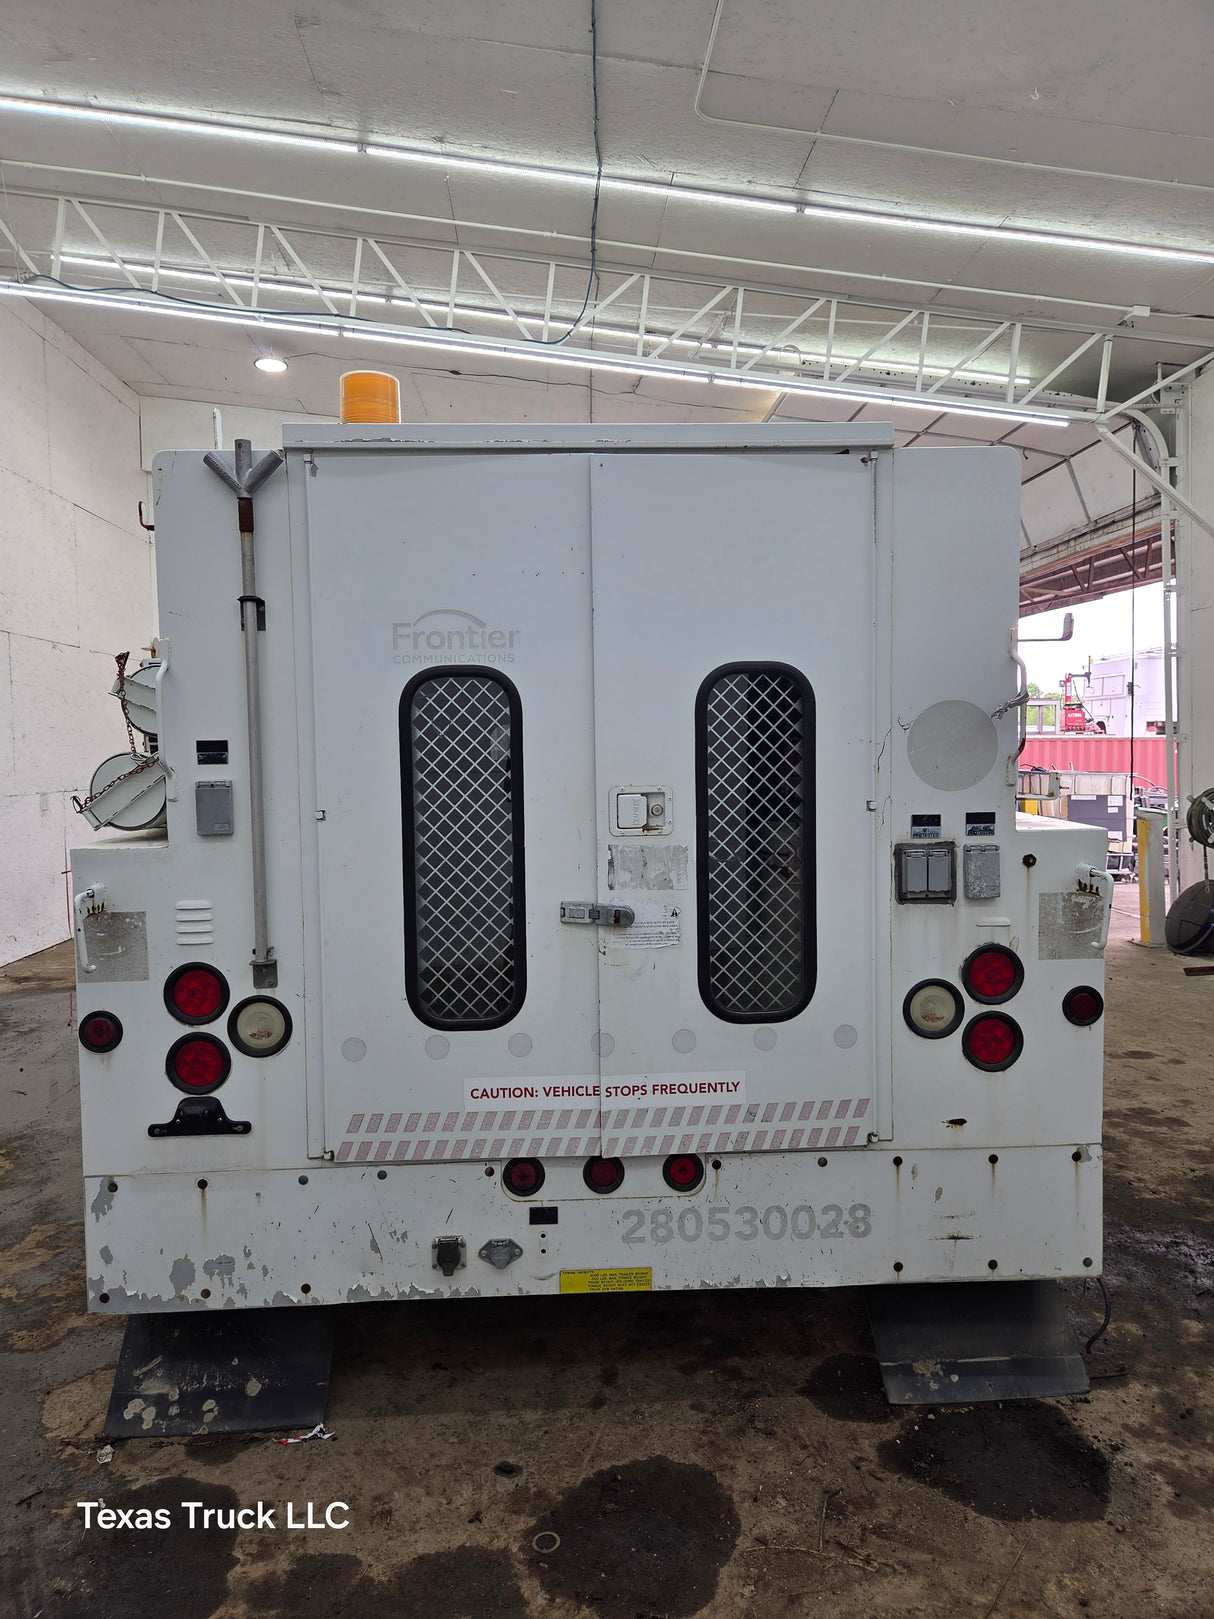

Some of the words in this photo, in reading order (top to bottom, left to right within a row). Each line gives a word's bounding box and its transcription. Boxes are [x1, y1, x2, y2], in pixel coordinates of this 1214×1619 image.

[391, 622, 520, 650] Frontier
[393, 653, 515, 664] COMMUNICATIONS
[470, 1087, 538, 1100] CAUTION:
[542, 1085, 600, 1098] VEHICLE
[605, 1085, 648, 1098] STOPS
[652, 1081, 741, 1096] FREQUENTLY
[621, 1203, 873, 1244] 280530028
